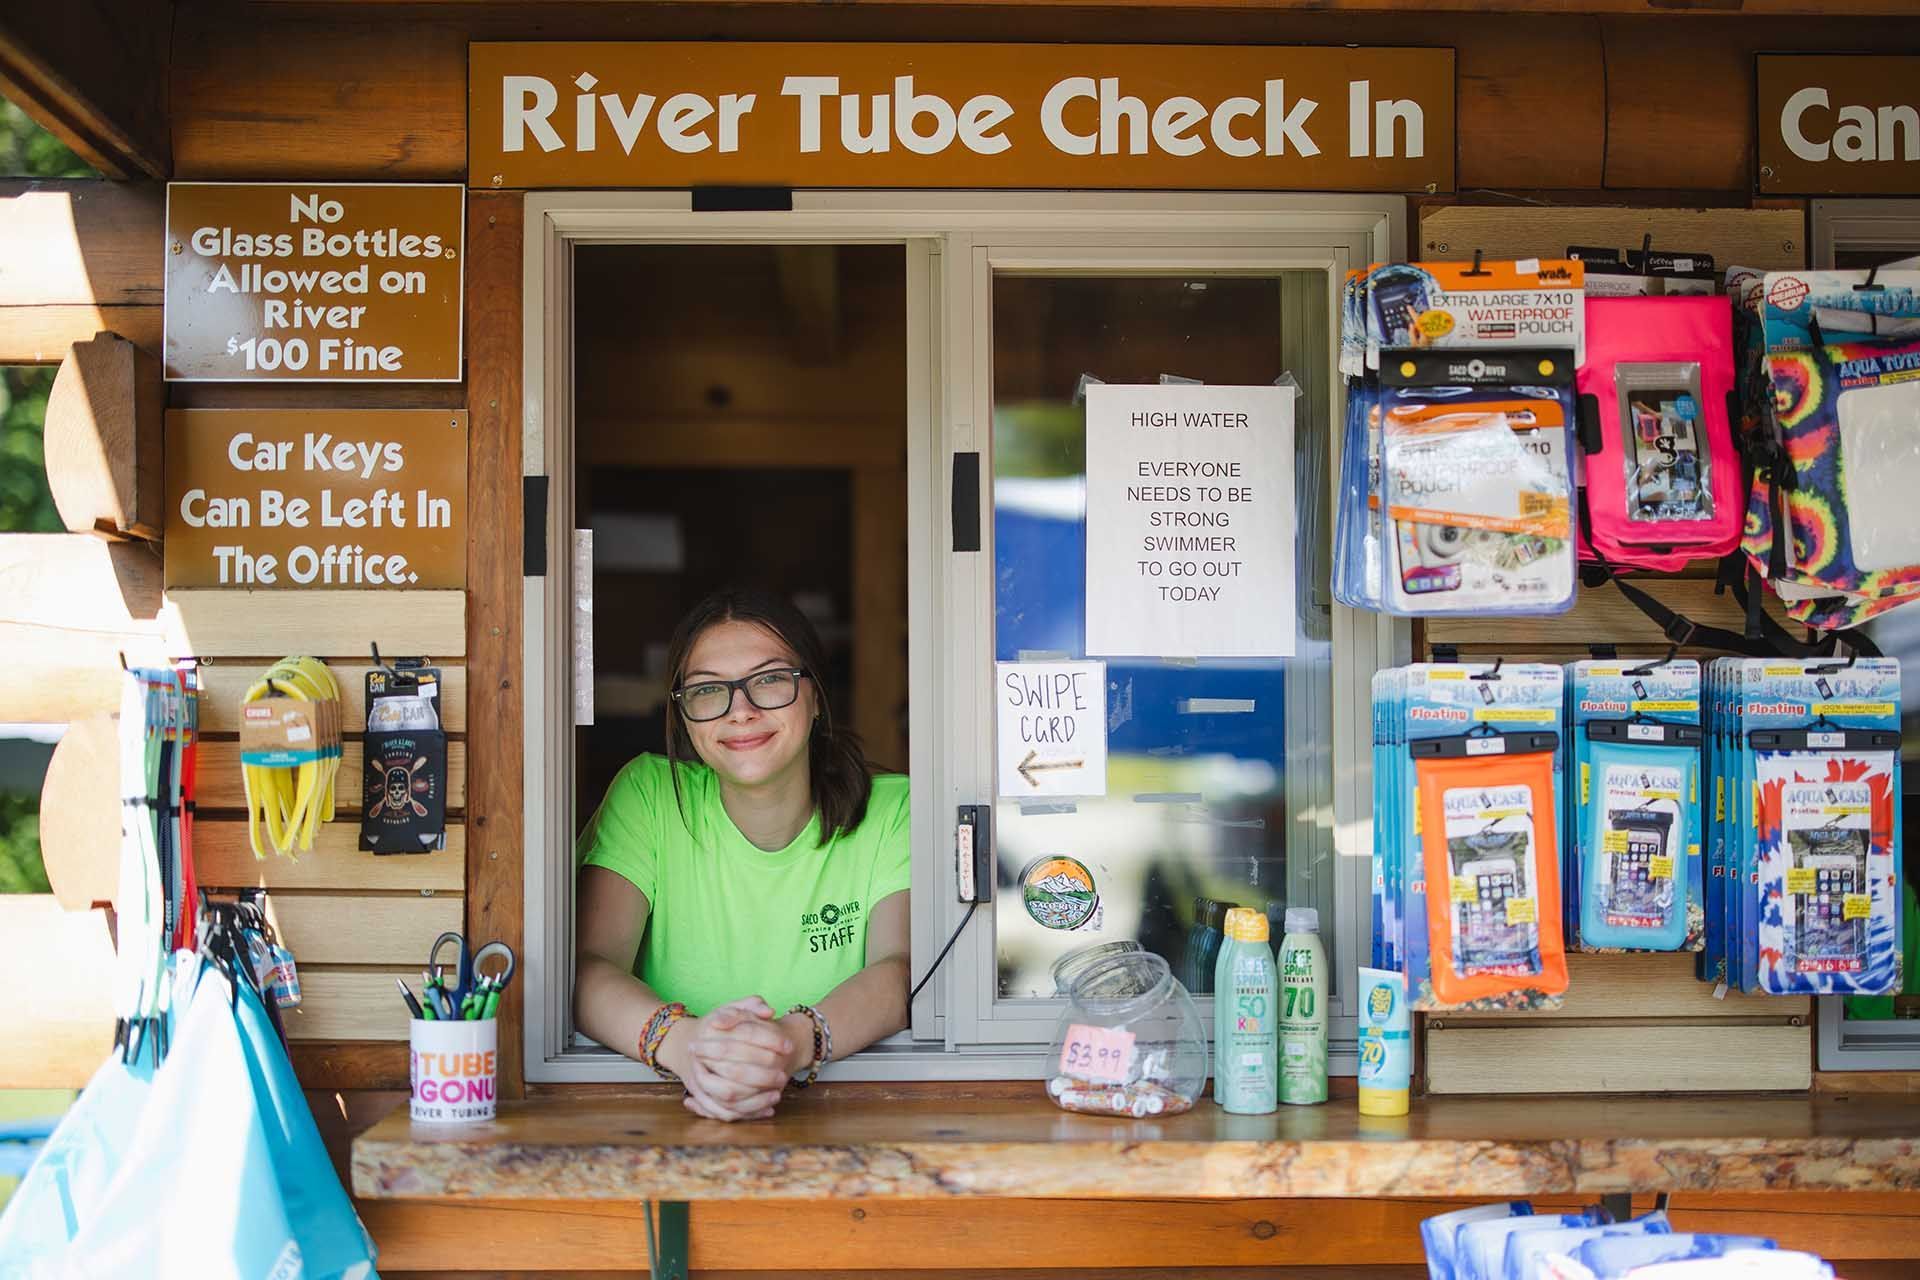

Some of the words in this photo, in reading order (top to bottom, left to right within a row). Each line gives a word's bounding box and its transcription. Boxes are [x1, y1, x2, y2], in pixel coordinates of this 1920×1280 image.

[503, 72, 756, 156] River
[781, 76, 1014, 155] Tube
[1041, 77, 1321, 157] Check
[1350, 80, 1423, 157] In
[1781, 88, 1920, 161] Can
[290, 194, 344, 223] No
[191, 226, 294, 257] Glass
[303, 228, 441, 257] Bottles
[207, 263, 368, 294] Allowed
[380, 271, 425, 294] on
[1585, 280, 1632, 292] ATERPROOF
[1432, 294, 1480, 307] EXTRA
[1483, 293, 1529, 306] LARGE
[1535, 293, 1574, 306] 7X10
[264, 299, 366, 329] River
[1468, 308, 1573, 321] WATERPROOF
[1519, 321, 1574, 334] POUCH
[227, 337, 309, 371] $100
[320, 338, 403, 371] Fine
[1839, 359, 1881, 379] AQUA
[1131, 412, 1177, 428] HIGH
[1183, 413, 1249, 428] WATER
[229, 433, 294, 470] Car
[305, 433, 403, 479] Keys
[1138, 462, 1241, 477] EVERYONE
[1127, 487, 1191, 502] NEEDS
[1197, 487, 1222, 502] TO
[1229, 488, 1252, 502] BE
[181, 490, 250, 527] Can
[261, 490, 310, 527] Be
[322, 489, 406, 527] Left
[418, 490, 450, 527] In
[1150, 512, 1230, 527] STRONG
[1144, 537, 1236, 552] SWIMMER
[213, 546, 277, 583] The
[288, 545, 418, 584] Office.
[1138, 561, 1163, 576] TO
[1168, 562, 1197, 577] GO
[1202, 562, 1242, 577] OUT
[1158, 586, 1221, 601] TODAY
[1006, 673, 1087, 711] SWIPE
[1748, 703, 1805, 716] Floating
[1020, 715, 1075, 743] CARD
[801, 913, 819, 926] SACO
[840, 901, 860, 917] RIVER
[809, 925, 855, 953] STAFF
[1236, 996, 1266, 1019] 50
[1284, 986, 1315, 1018] 70
[420, 1051, 496, 1077] TUBE
[1361, 1041, 1383, 1064] 70
[451, 1106, 489, 1119] TUBING
